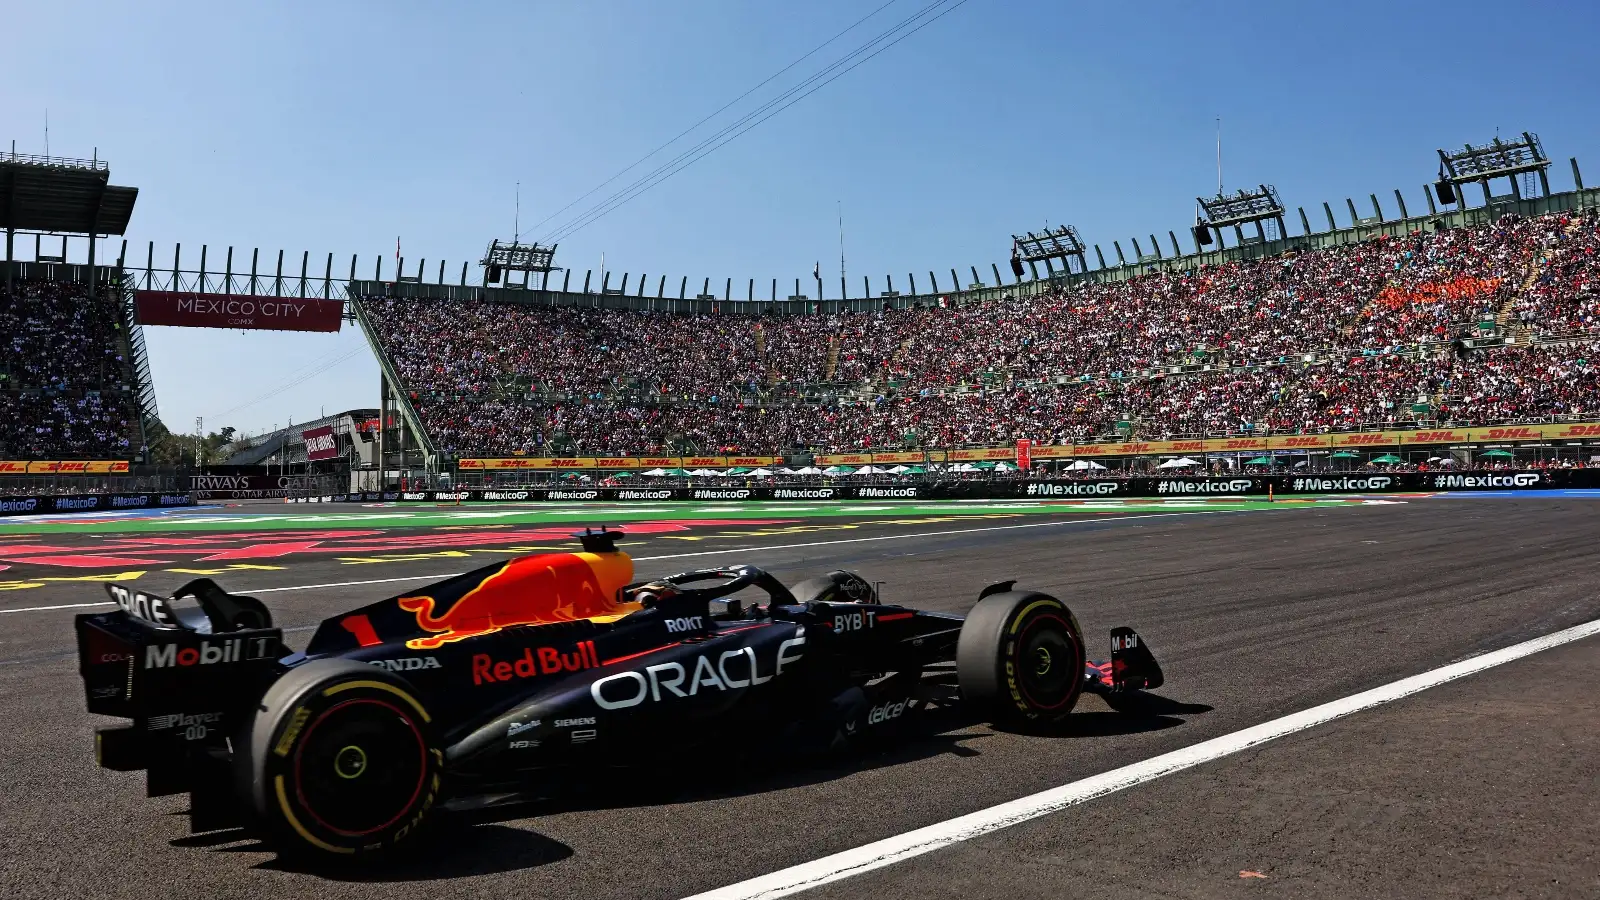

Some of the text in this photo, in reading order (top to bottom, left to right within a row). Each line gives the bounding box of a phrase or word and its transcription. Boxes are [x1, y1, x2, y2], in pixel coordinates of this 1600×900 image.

[177, 298, 306, 317] MEXICO CITY
[1345, 434, 1387, 443] DHL
[1412, 431, 1458, 441] DHL
[1485, 428, 1535, 439] DHL
[1225, 440, 1260, 448] DHL
[1283, 436, 1321, 446] DHL
[1031, 447, 1056, 456] DHL
[1073, 446, 1102, 454] DHL
[1120, 444, 1152, 452] DHL
[1171, 442, 1204, 451] DHL
[874, 454, 897, 462] DHL
[986, 449, 1012, 458] DHL
[499, 460, 531, 468] DHL
[548, 459, 580, 467] DHL
[599, 459, 628, 467] DHL
[644, 459, 673, 467] DHL
[689, 458, 717, 466] DHL
[733, 458, 760, 466] DHL
[842, 455, 863, 463] DHL
[46, 462, 88, 471] DHL
[190, 477, 249, 489] IRWAYS
[1292, 476, 1391, 491] #MexicoGP
[1434, 473, 1539, 488] #MexicoGP
[1027, 482, 1118, 496] #MexicoGP
[1158, 480, 1251, 493] #MexicoGP
[232, 490, 263, 499] QATAR
[484, 491, 528, 500] #MexicoGP
[548, 491, 597, 499] #MexicoGP
[619, 490, 671, 499] #MexicoGP
[694, 489, 750, 499] #MexicoGP
[774, 488, 833, 498] #MexicoGP
[56, 497, 98, 509] #MexicoGP
[113, 496, 148, 507] #MexicoGP
[663, 615, 703, 633] ROKT
[834, 608, 876, 633] BYBIT
[341, 614, 384, 647] 1
[1112, 633, 1138, 652] Mobil
[144, 638, 267, 671] Mobil 1
[590, 637, 806, 711] ORACLE
[867, 696, 910, 725] telcel
[168, 711, 224, 729] Player
[553, 716, 597, 728] SIEMENS
